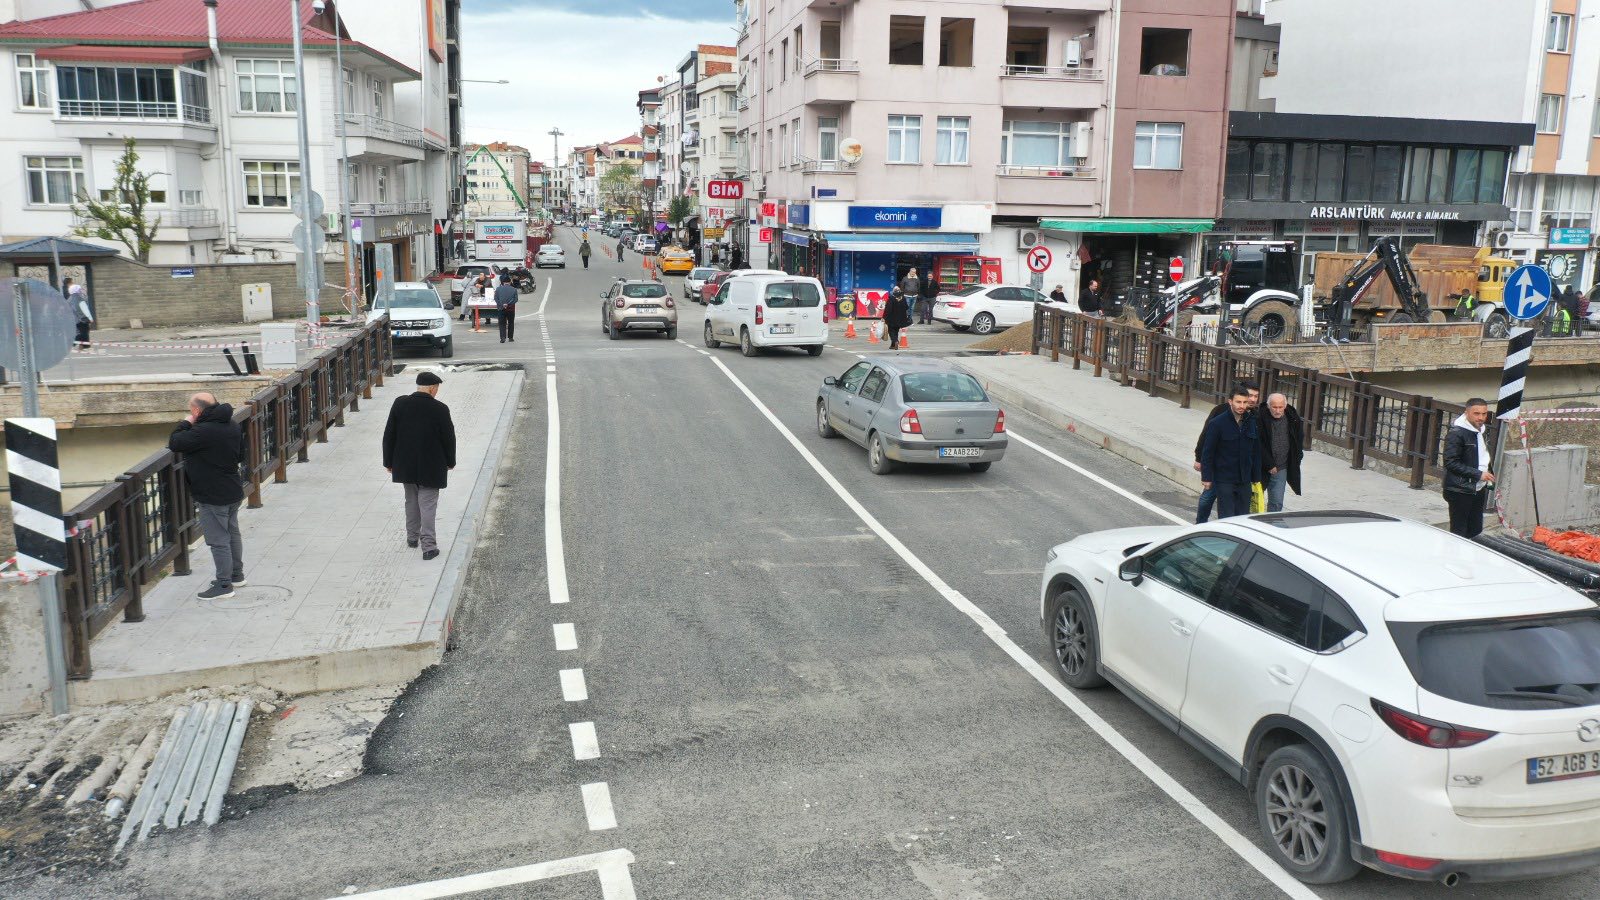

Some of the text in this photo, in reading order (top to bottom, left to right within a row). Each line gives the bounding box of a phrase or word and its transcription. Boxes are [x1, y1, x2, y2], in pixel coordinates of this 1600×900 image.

[711, 182, 739, 196] BİM
[874, 211, 907, 221] ekomini
[1310, 205, 1385, 219] ARSLANTÜRK
[1390, 209, 1415, 220] İNŞAAT
[1424, 210, 1459, 220] MİMARLIK
[1538, 759, 1554, 776] 52
[1562, 753, 1586, 772] AGB
